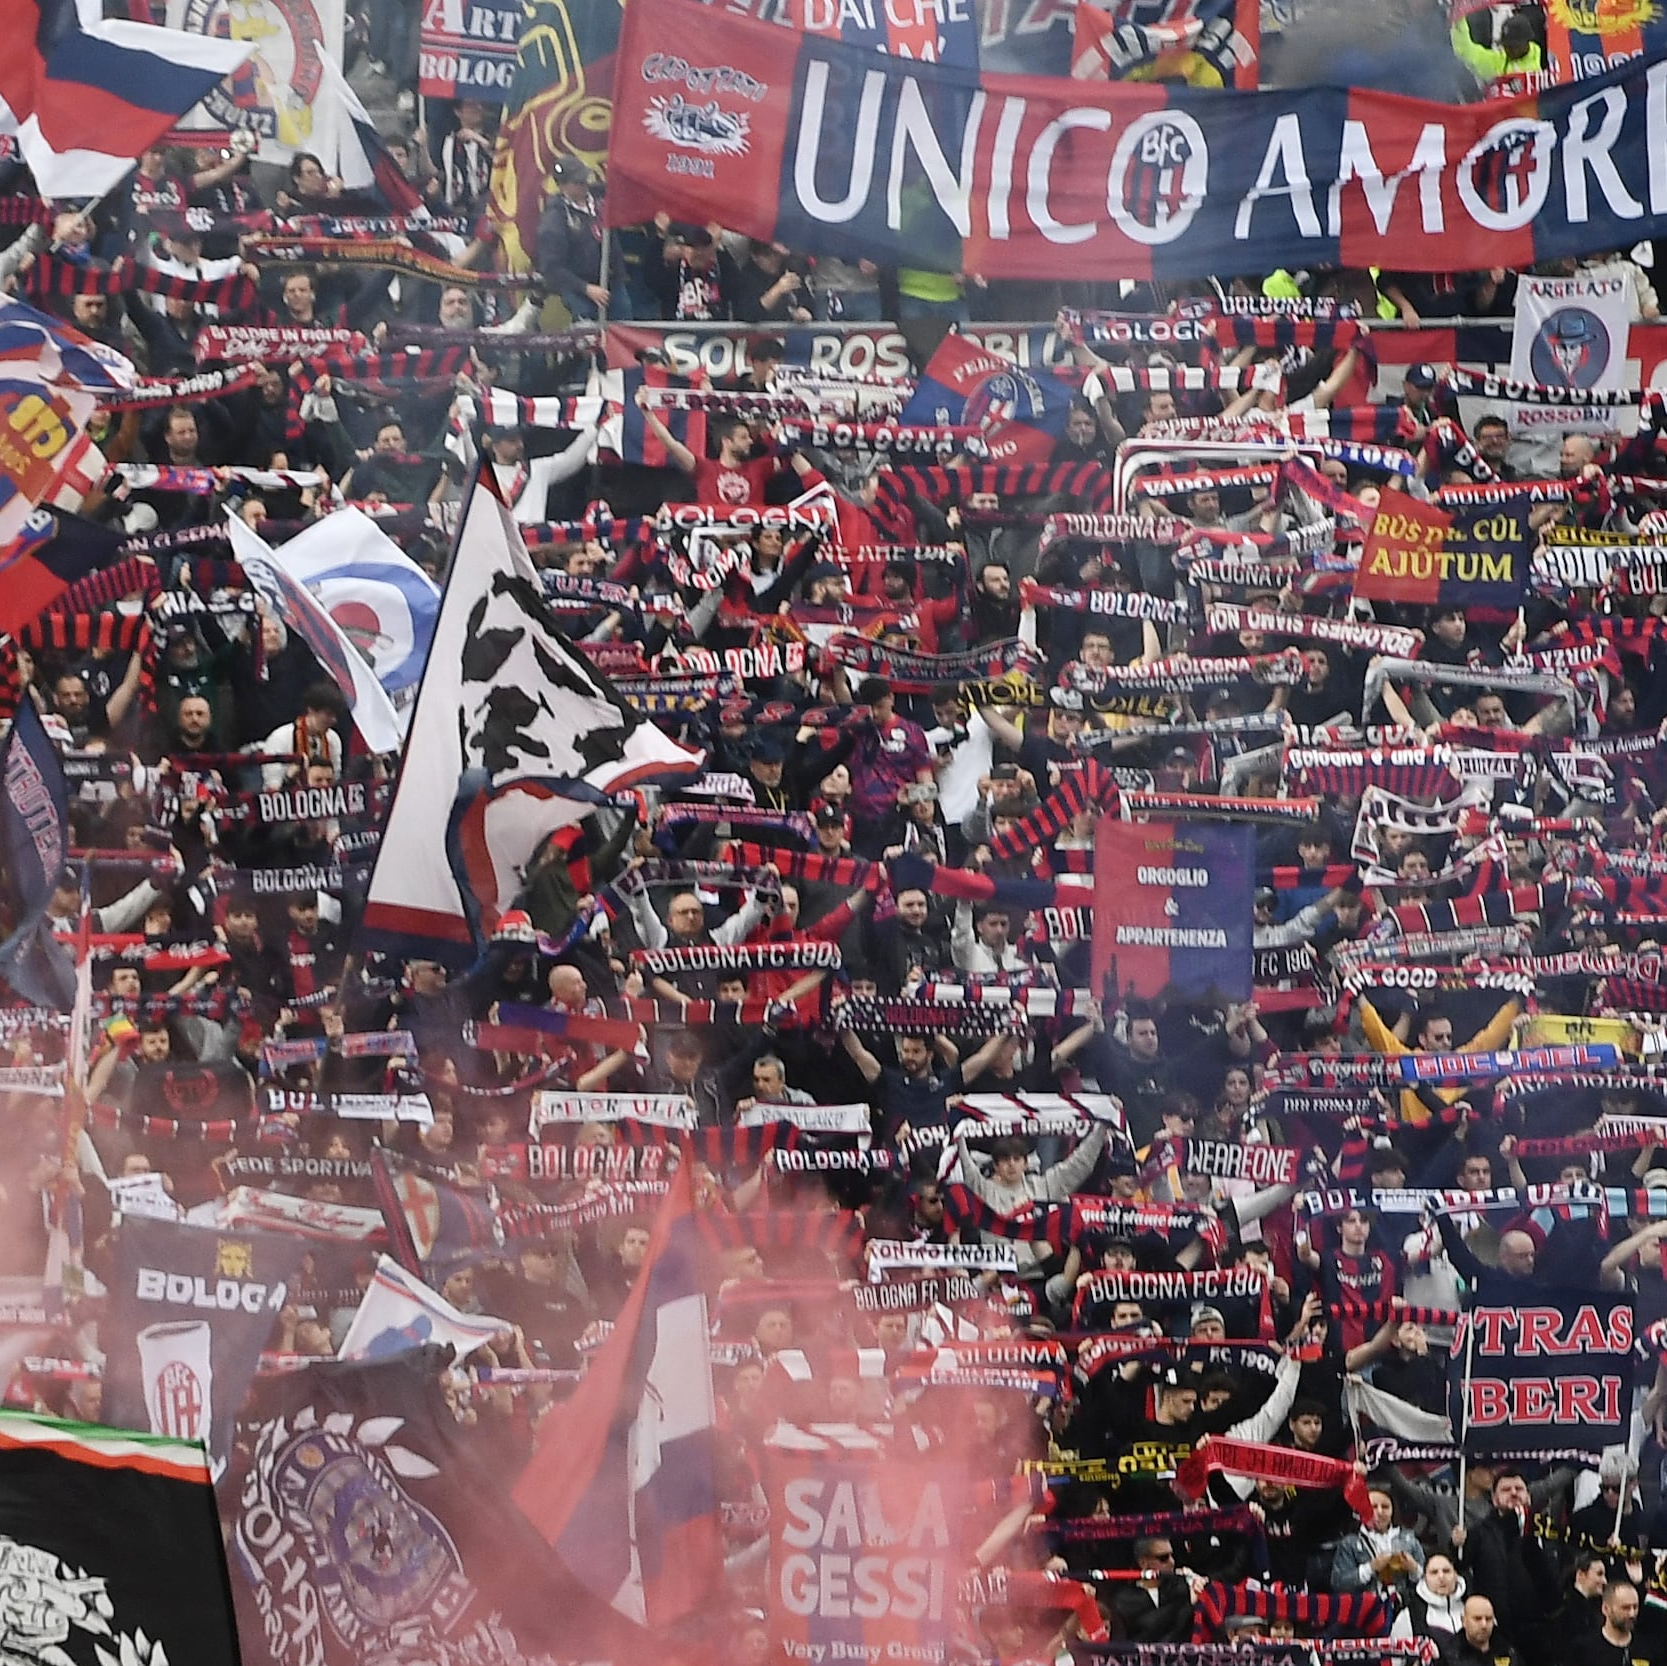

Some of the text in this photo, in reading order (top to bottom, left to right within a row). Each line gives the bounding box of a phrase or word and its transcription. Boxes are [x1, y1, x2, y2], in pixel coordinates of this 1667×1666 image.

[794, 57, 1209, 246] UNICO
[1527, 277, 1623, 299] ARGELATO
[811, 427, 955, 453] BOLOGNA
[1368, 549, 1515, 582] AJÛTUM
[1089, 592, 1175, 622] BOLOGNA
[1287, 749, 1364, 769] Bologna
[259, 788, 347, 822] BOLOGNA
[252, 867, 328, 892] BOLOGNA
[1136, 867, 1210, 888] ORGOGLIO
[1163, 896, 1180, 918] &
[1043, 905, 1094, 942] BOL
[1115, 926, 1228, 949] APPARTENENZA
[644, 944, 785, 974] BOLOGNA FC
[1382, 967, 1438, 989] GOOD
[1413, 1044, 1603, 1079] SOC MEL
[281, 1155, 373, 1179] SPORTIVA
[527, 1142, 635, 1182] BOLOGNA
[1090, 1271, 1188, 1302] BOLOGNA
[1191, 1272, 1218, 1299] FC
[1465, 1376, 1622, 1427] BERI
[780, 1553, 946, 1622] GESSI
[781, 1638, 946, 1665] Very Busy Group
